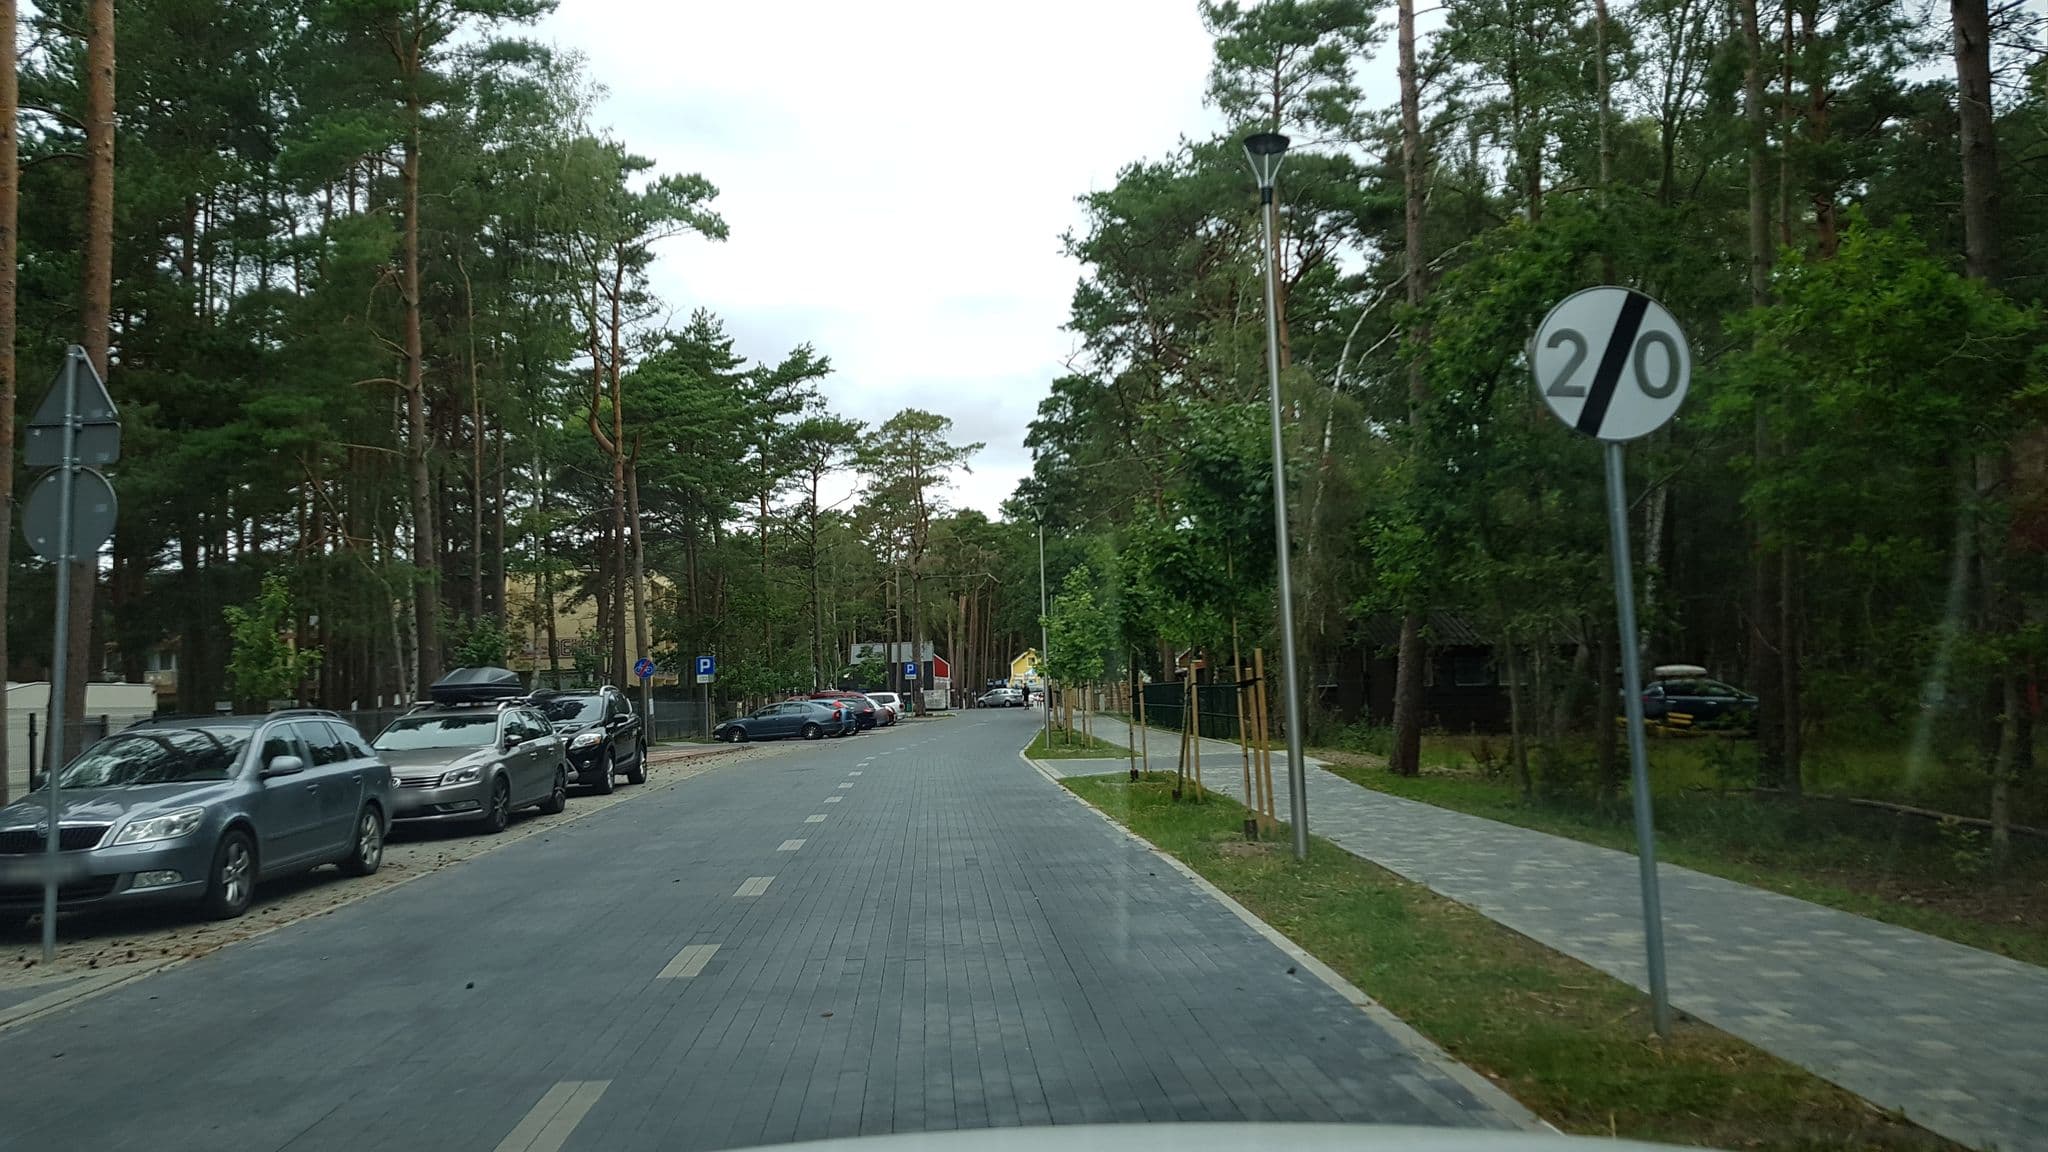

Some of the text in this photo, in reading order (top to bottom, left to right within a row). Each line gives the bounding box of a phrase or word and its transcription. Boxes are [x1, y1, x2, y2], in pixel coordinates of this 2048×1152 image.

[1546, 328, 1681, 399] 20
[700, 659, 710, 672] P
[907, 664, 914, 673] P
